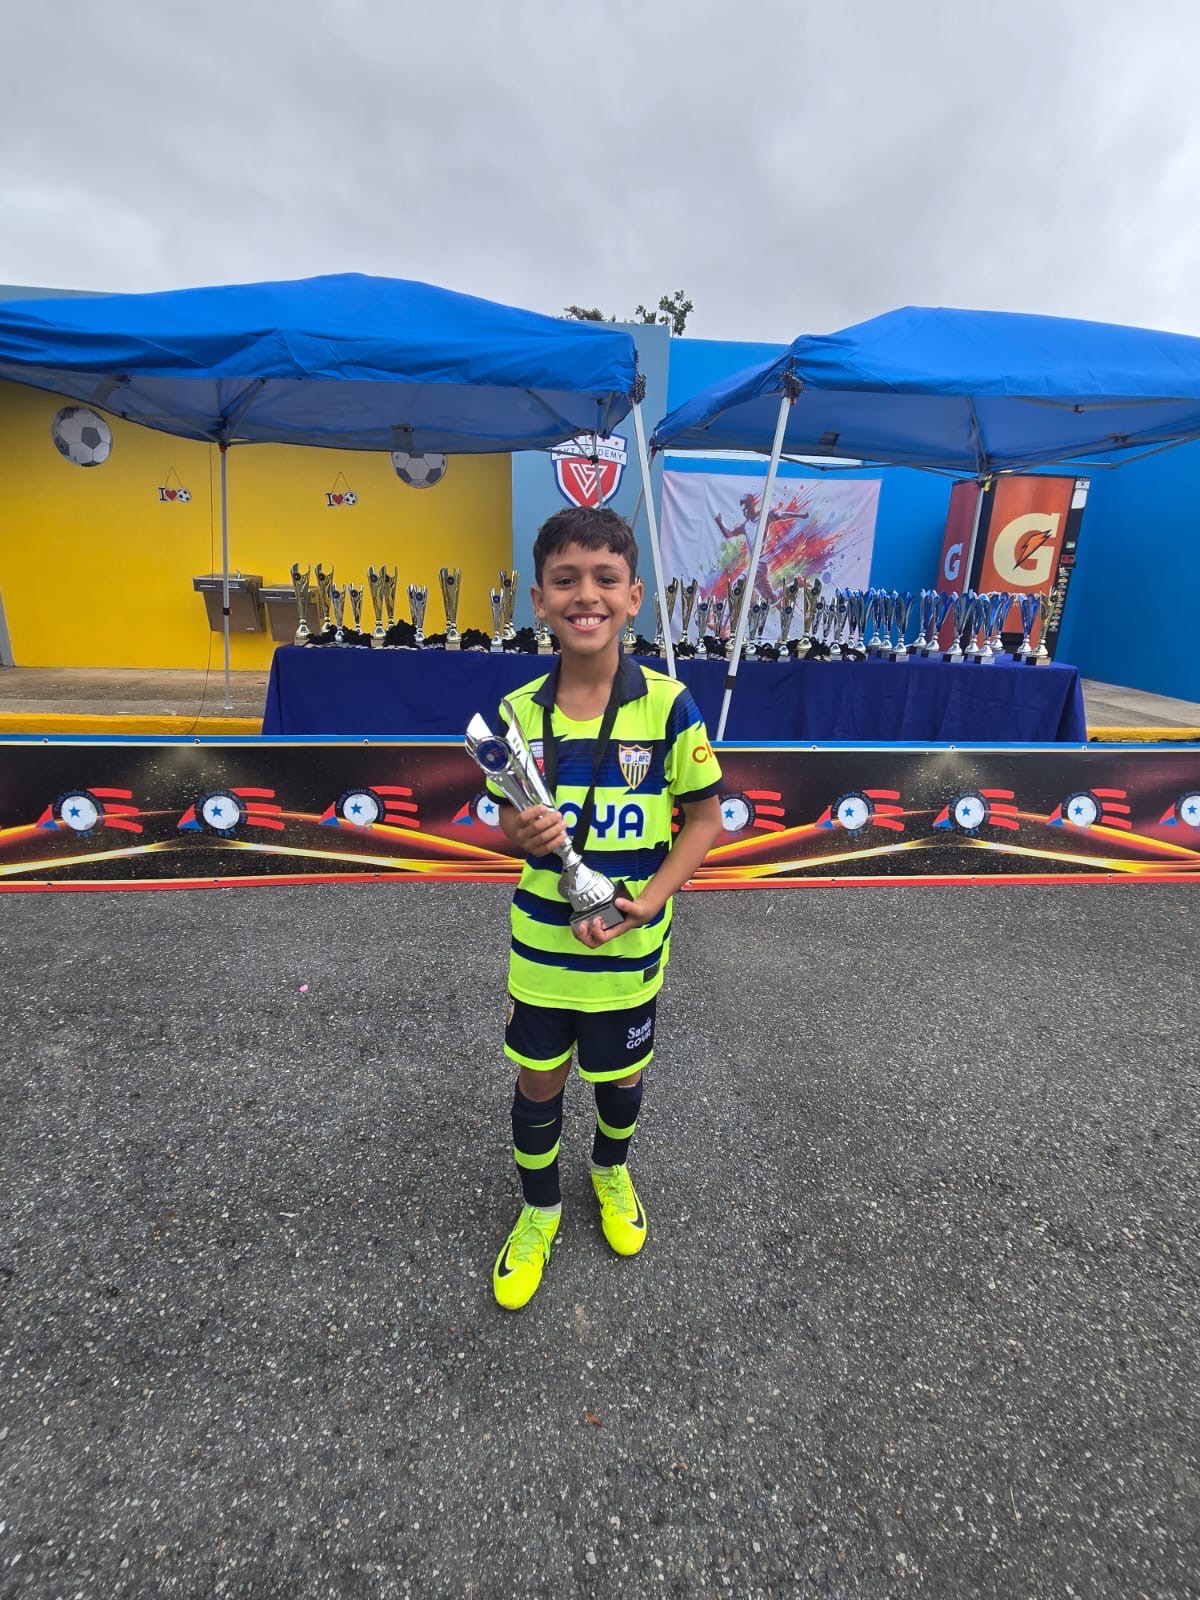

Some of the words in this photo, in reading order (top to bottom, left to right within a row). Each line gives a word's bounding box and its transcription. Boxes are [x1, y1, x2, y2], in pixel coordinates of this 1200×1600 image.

[944, 543, 963, 581] G
[993, 512, 1060, 587] G
[558, 802, 645, 839] OYA
